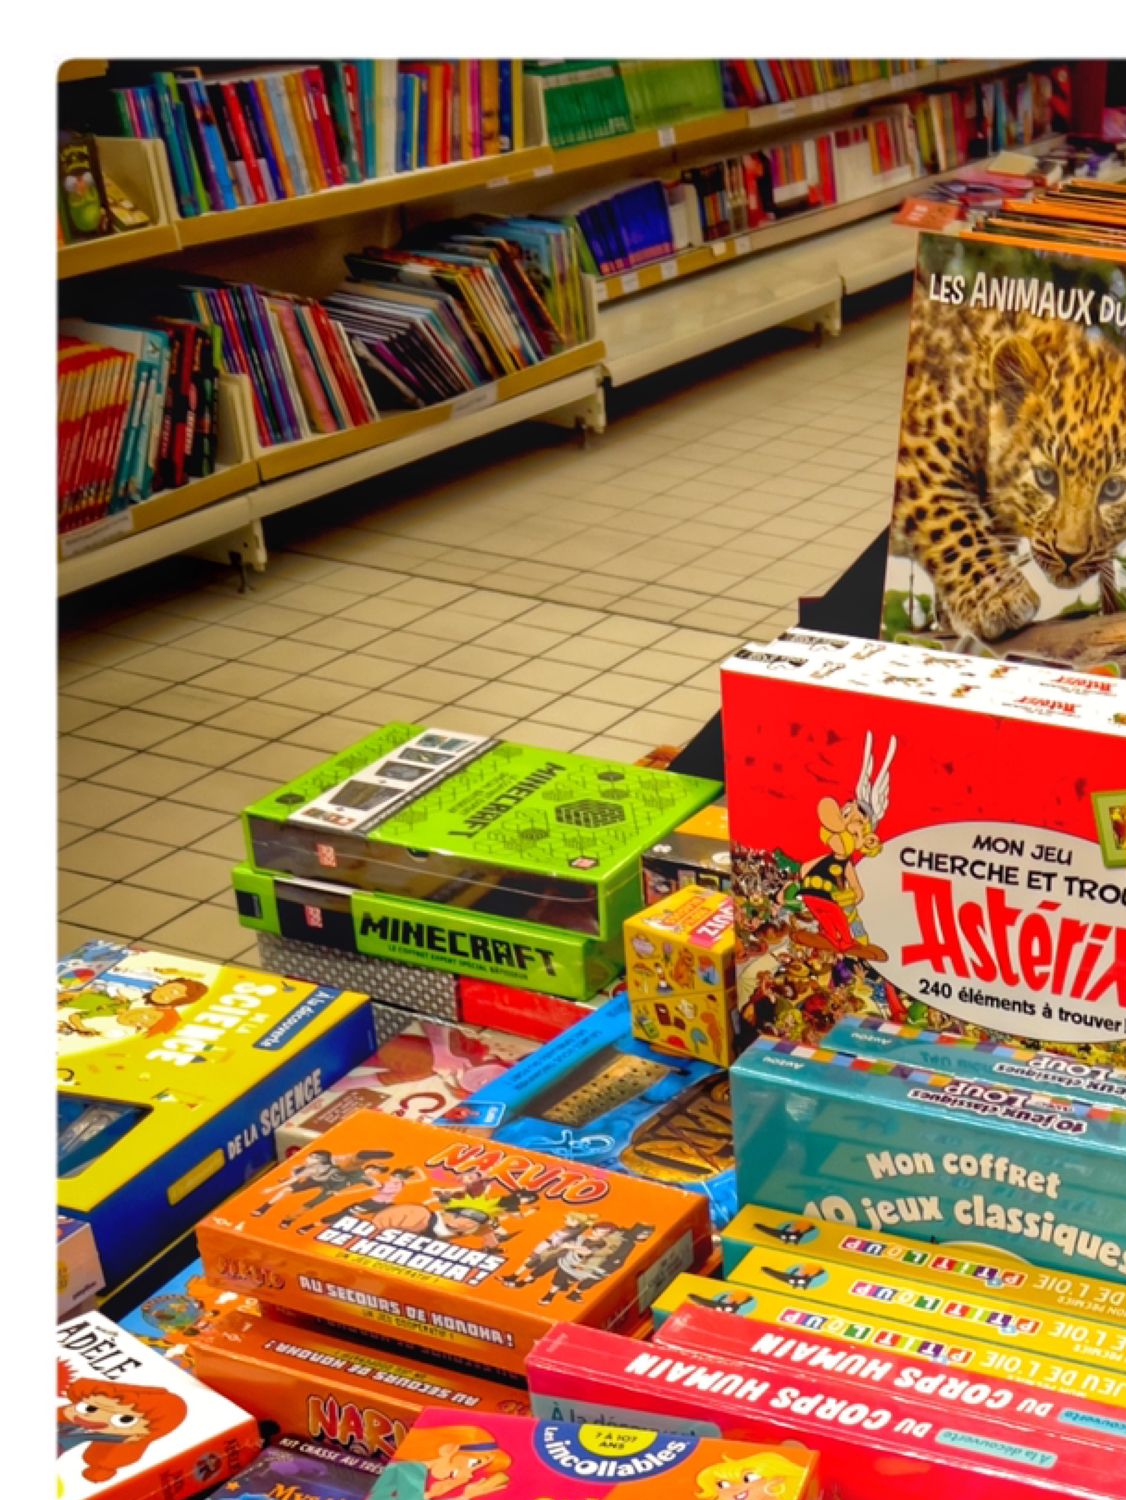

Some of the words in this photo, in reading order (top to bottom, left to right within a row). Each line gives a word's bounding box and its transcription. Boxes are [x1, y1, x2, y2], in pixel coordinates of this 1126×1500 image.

[929, 274, 965, 305] LES
[970, 272, 1096, 326] ANIMAUX
[447, 761, 566, 840] MINECRAFT
[899, 847, 1019, 885] CHERCHE
[1027, 871, 1057, 892] ET
[972, 834, 1025, 857] MON
[1031, 847, 1073, 866] JEU
[360, 913, 555, 976] MINECRAFT
[918, 978, 953, 998] 240
[958, 985, 1036, 1016] éléments
[1042, 1002, 1053, 1019] à
[146, 982, 277, 1066] SCIENCE
[226, 1138, 243, 1160] DE
[244, 1126, 259, 1148] LA
[260, 1069, 322, 1131] SCIENCE
[908, 1087, 992, 1117] classiques
[942, 1078, 1026, 1109] LOUP
[997, 1102, 1049, 1132] jeux
[1057, 1116, 1087, 1137] 10
[425, 1143, 609, 1204] NARUTO
[866, 1151, 937, 1183] Mon
[943, 1151, 1062, 1199] coffret
[333, 1216, 375, 1239] AU
[381, 1227, 505, 1273] SECOURS
[777, 1308, 869, 1344] LOUP
[57, 1321, 142, 1381] ADÈLE
[755, 1331, 889, 1386] HUMAIN
[986, 1349, 1044, 1384] L'OIE
[626, 1348, 766, 1406] HUMAIN
[894, 1364, 1014, 1410] CORPS
[1048, 1365, 1079, 1390] DE
[1084, 1373, 1126, 1402] JEU
[769, 1386, 891, 1434] CORPS
[895, 1415, 930, 1440] DU
[1017, 1396, 1052, 1419] DU
[940, 1428, 1019, 1461] découverte
